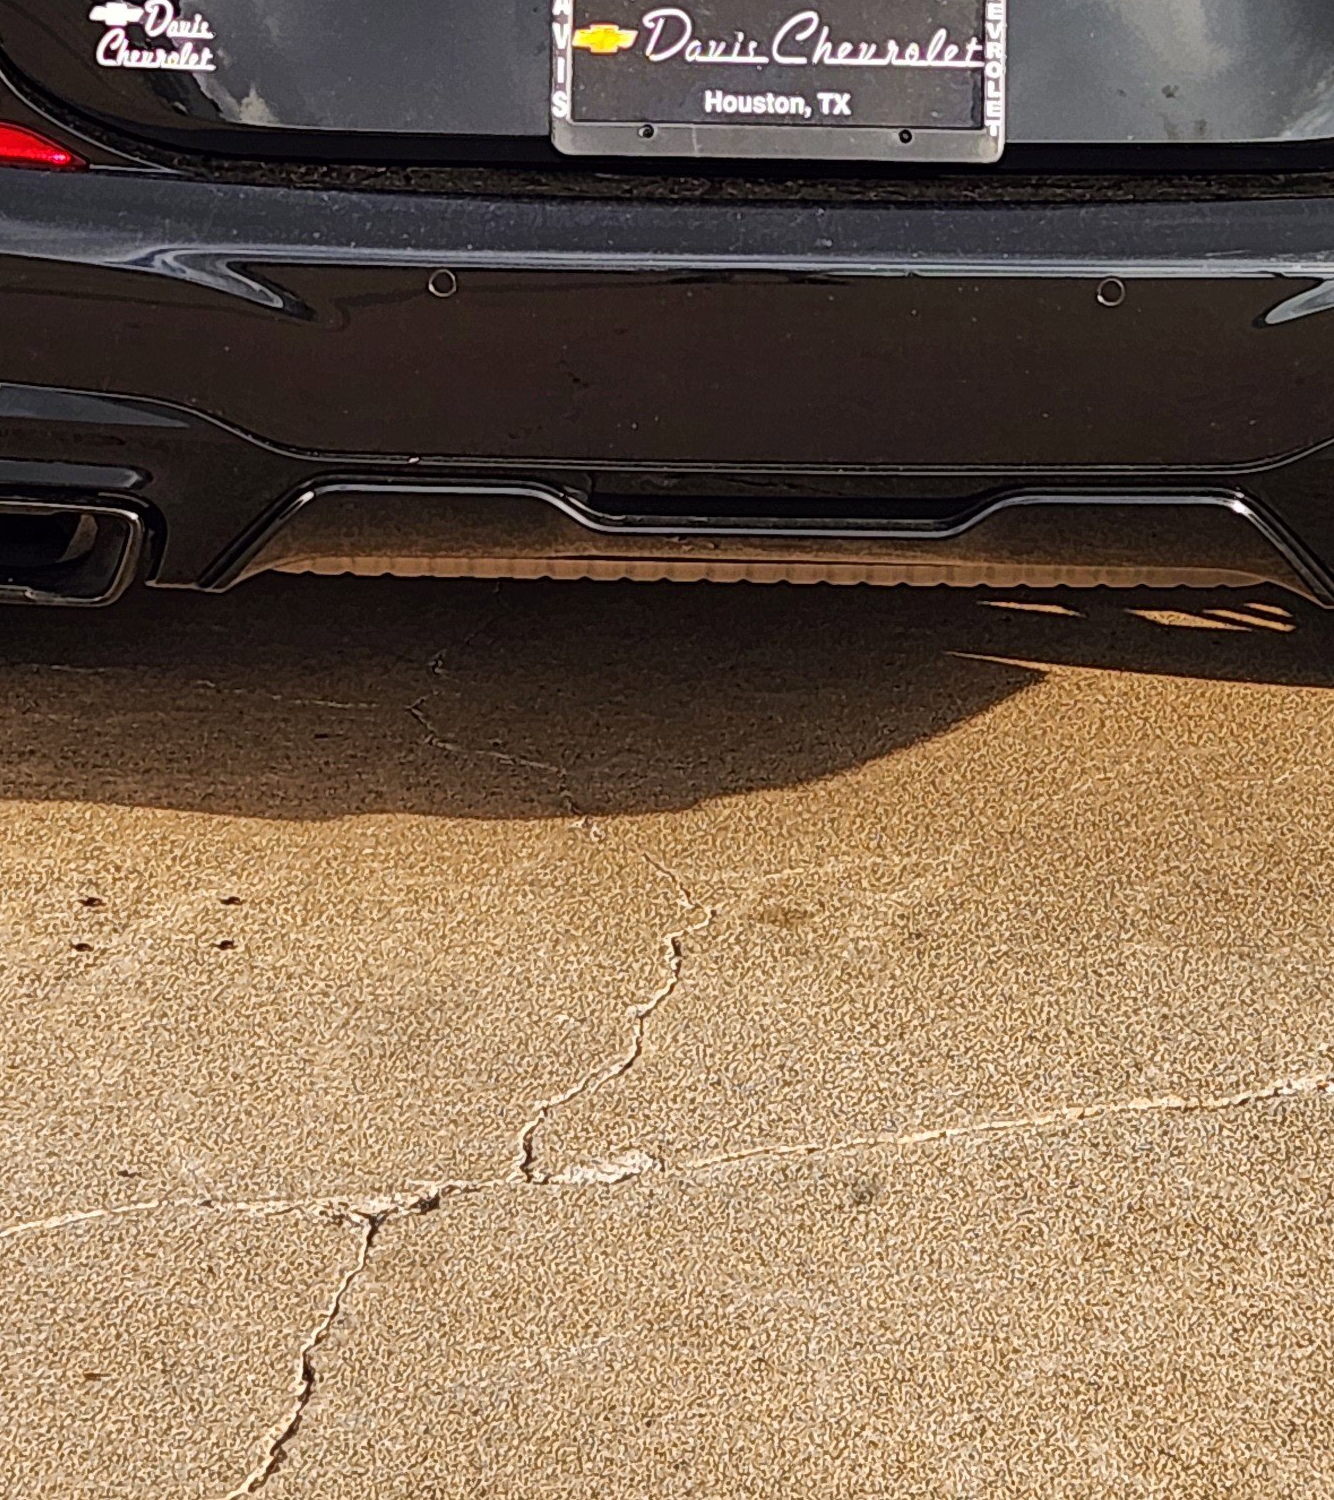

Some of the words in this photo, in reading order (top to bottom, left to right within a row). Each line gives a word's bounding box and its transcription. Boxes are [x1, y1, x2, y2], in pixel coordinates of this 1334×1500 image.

[95, 27, 217, 72] Chevrolet
[642, 7, 769, 62] Davis
[772, 10, 985, 68] Chevrolet
[704, 90, 812, 118] Houston,
[817, 92, 852, 116] TX
